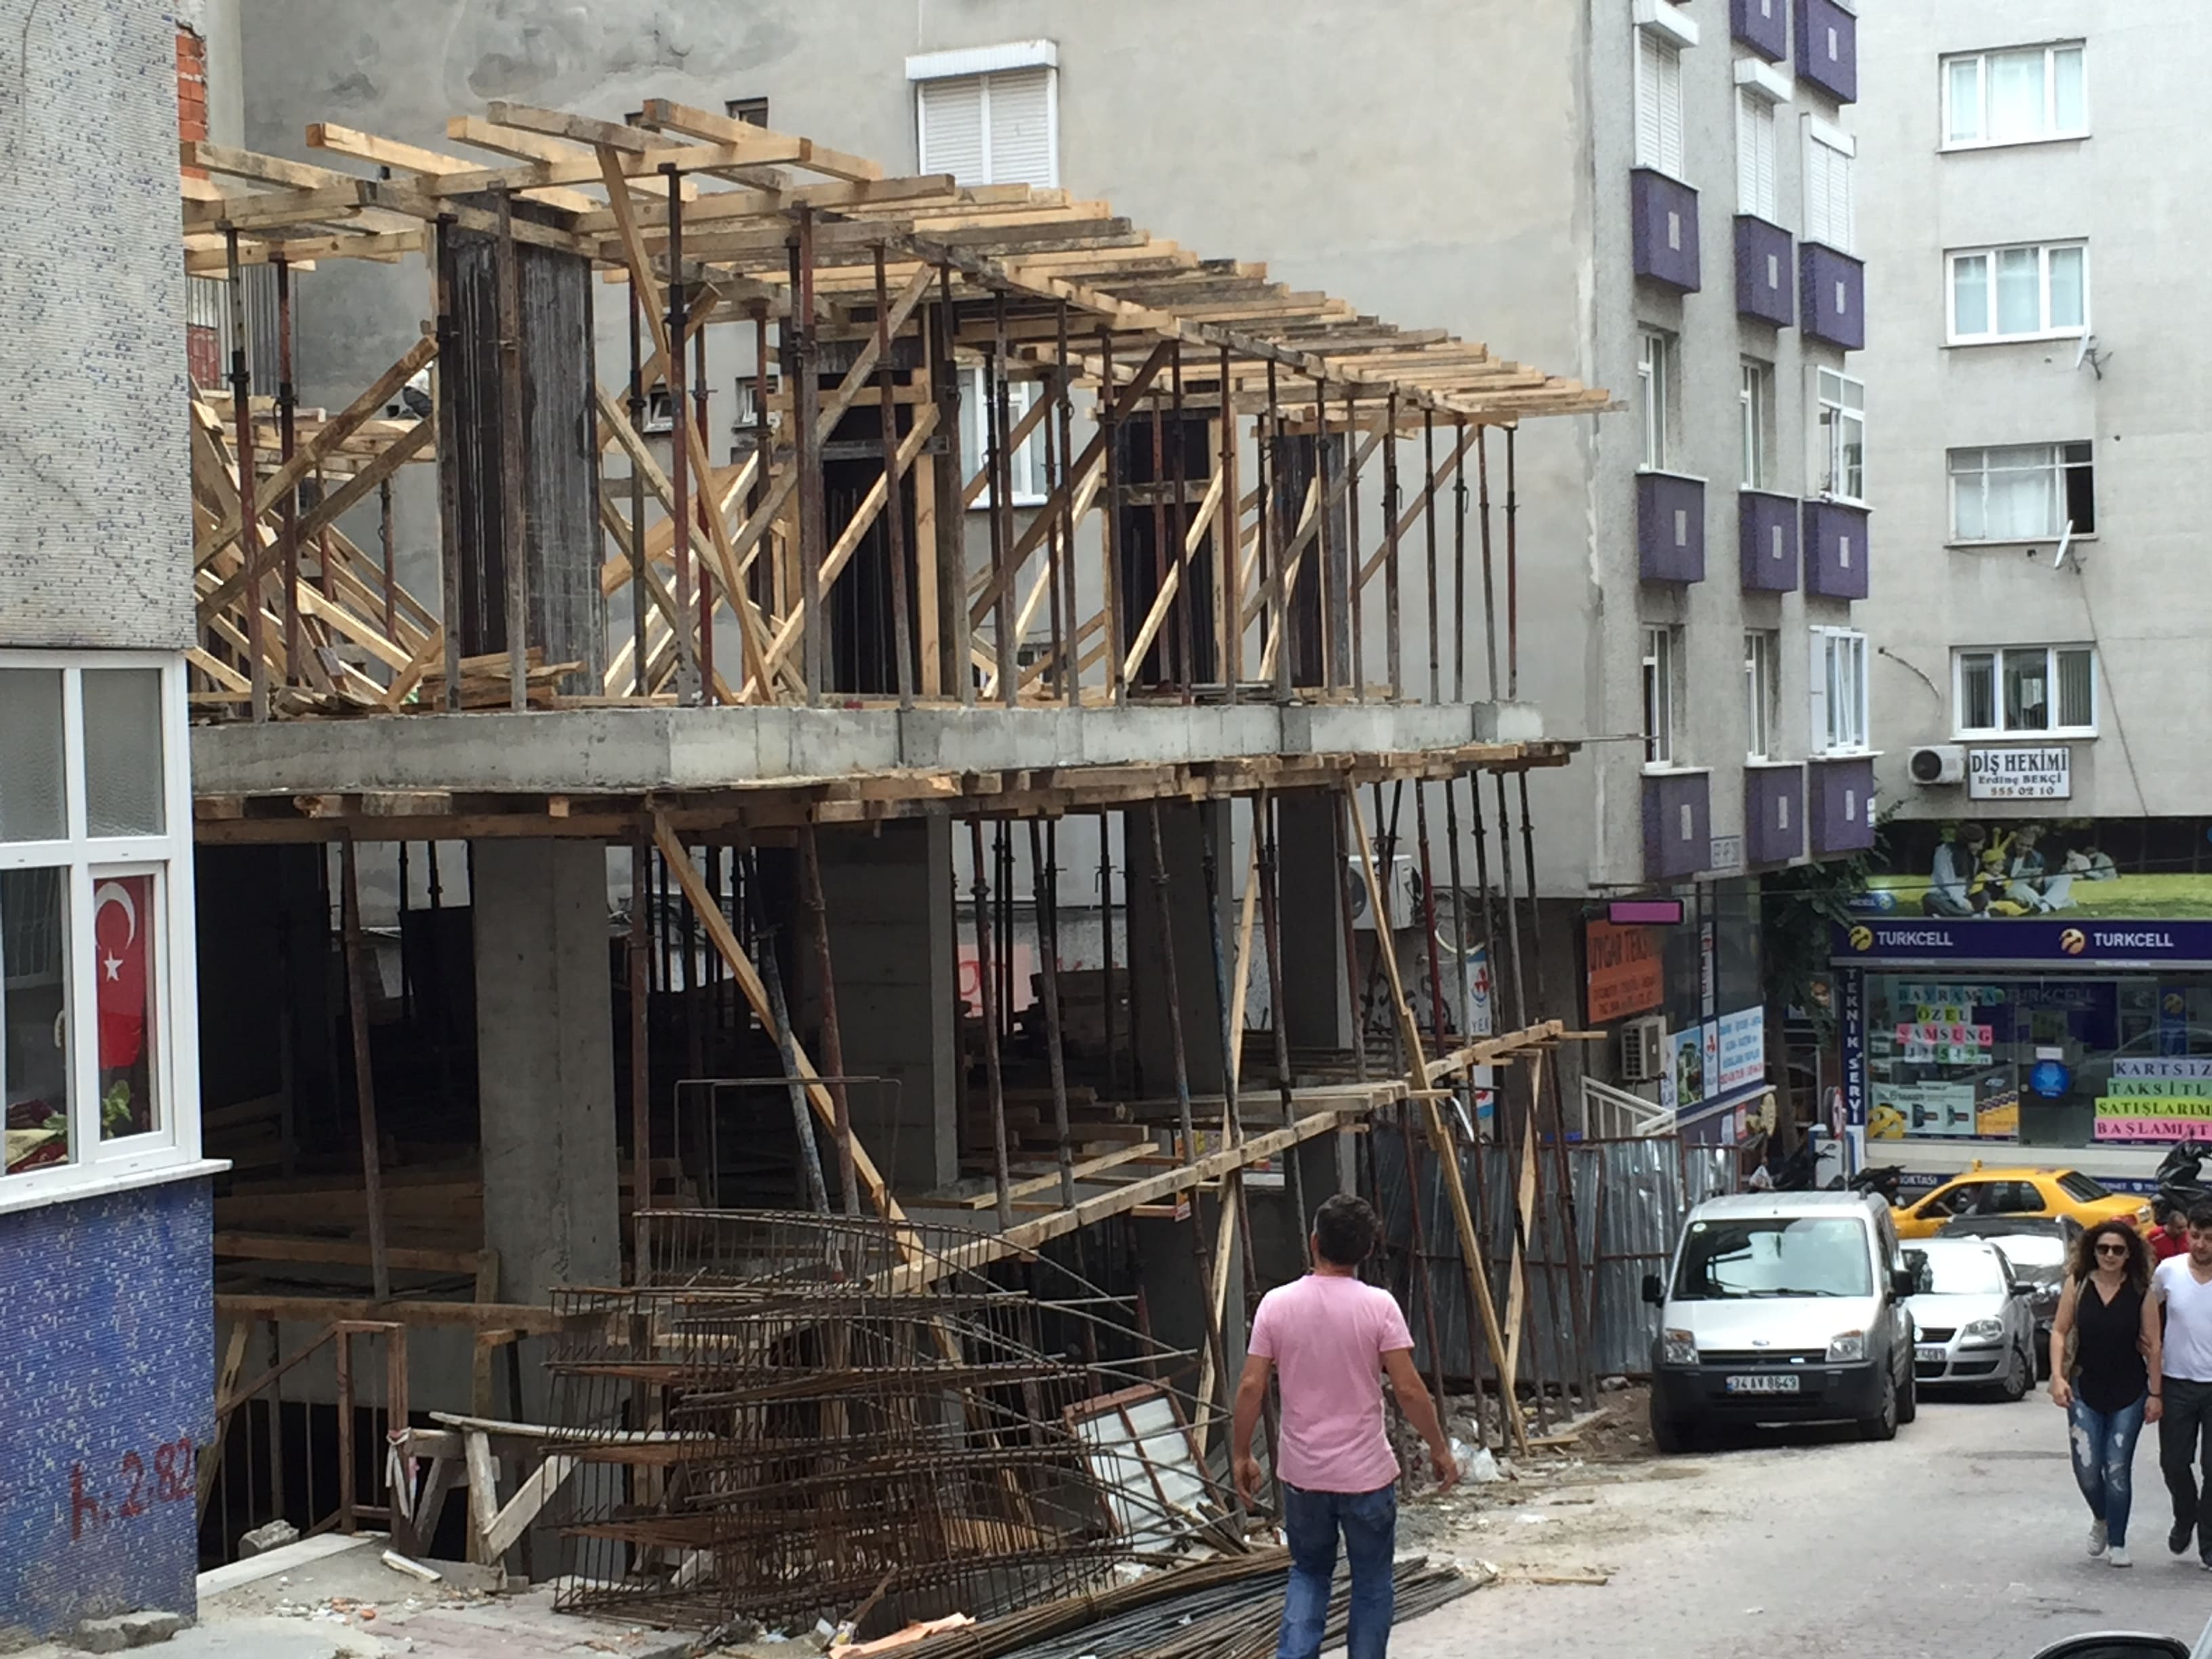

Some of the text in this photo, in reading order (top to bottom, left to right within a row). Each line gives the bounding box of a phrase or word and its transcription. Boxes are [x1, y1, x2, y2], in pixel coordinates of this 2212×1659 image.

[1971, 749, 2066, 775] DİŞ HEKİMİ
[2040, 787, 2054, 796] 10
[1877, 932, 1953, 946] TURKCELL
[2093, 933, 2174, 947] TURKCELL
[1898, 1029, 1990, 1042] SAMSUNG
